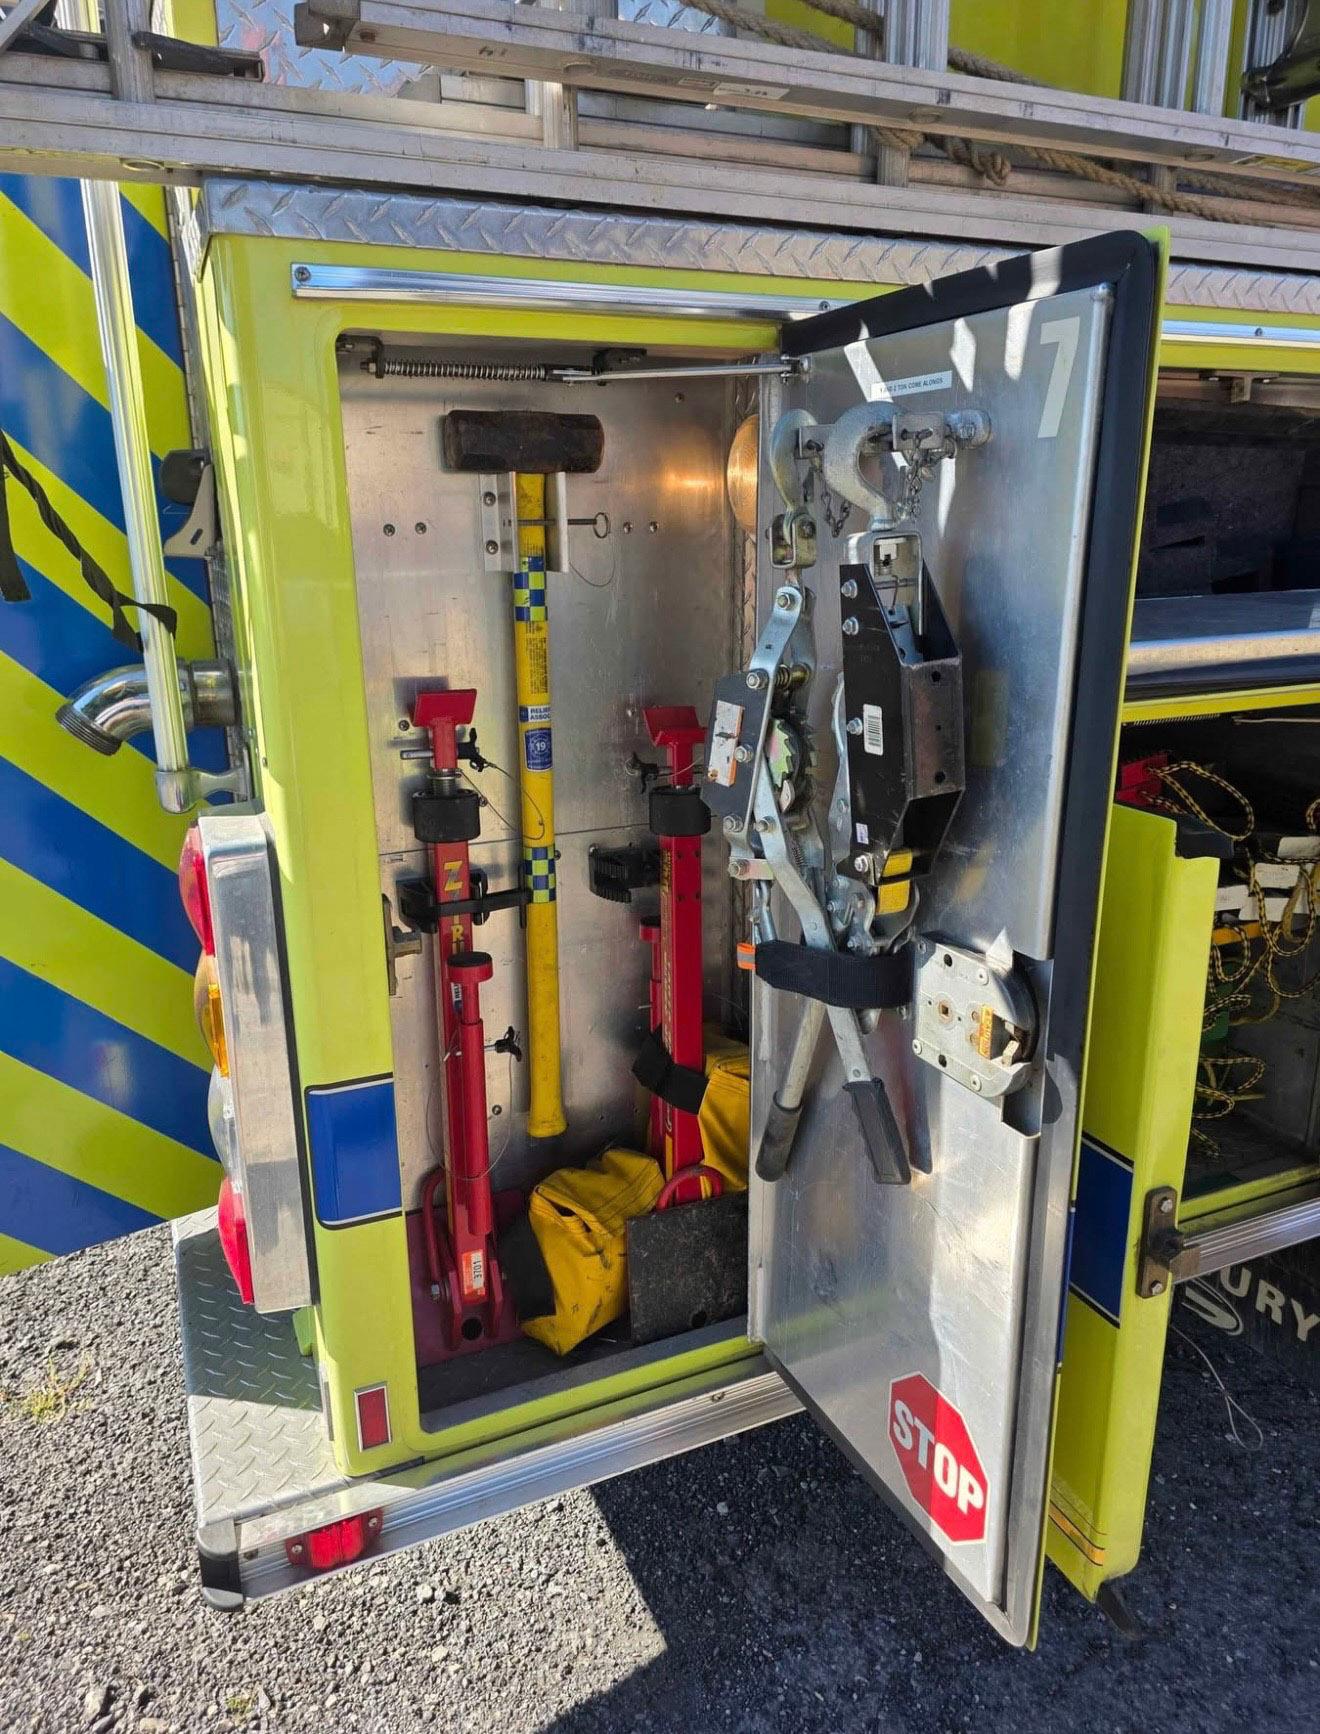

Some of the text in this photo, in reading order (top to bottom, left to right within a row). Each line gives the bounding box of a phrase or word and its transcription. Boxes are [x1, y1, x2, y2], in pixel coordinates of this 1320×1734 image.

[1038, 315, 1080, 438] 7
[535, 741, 546, 751] 19
[893, 1399, 984, 1515] STOP
